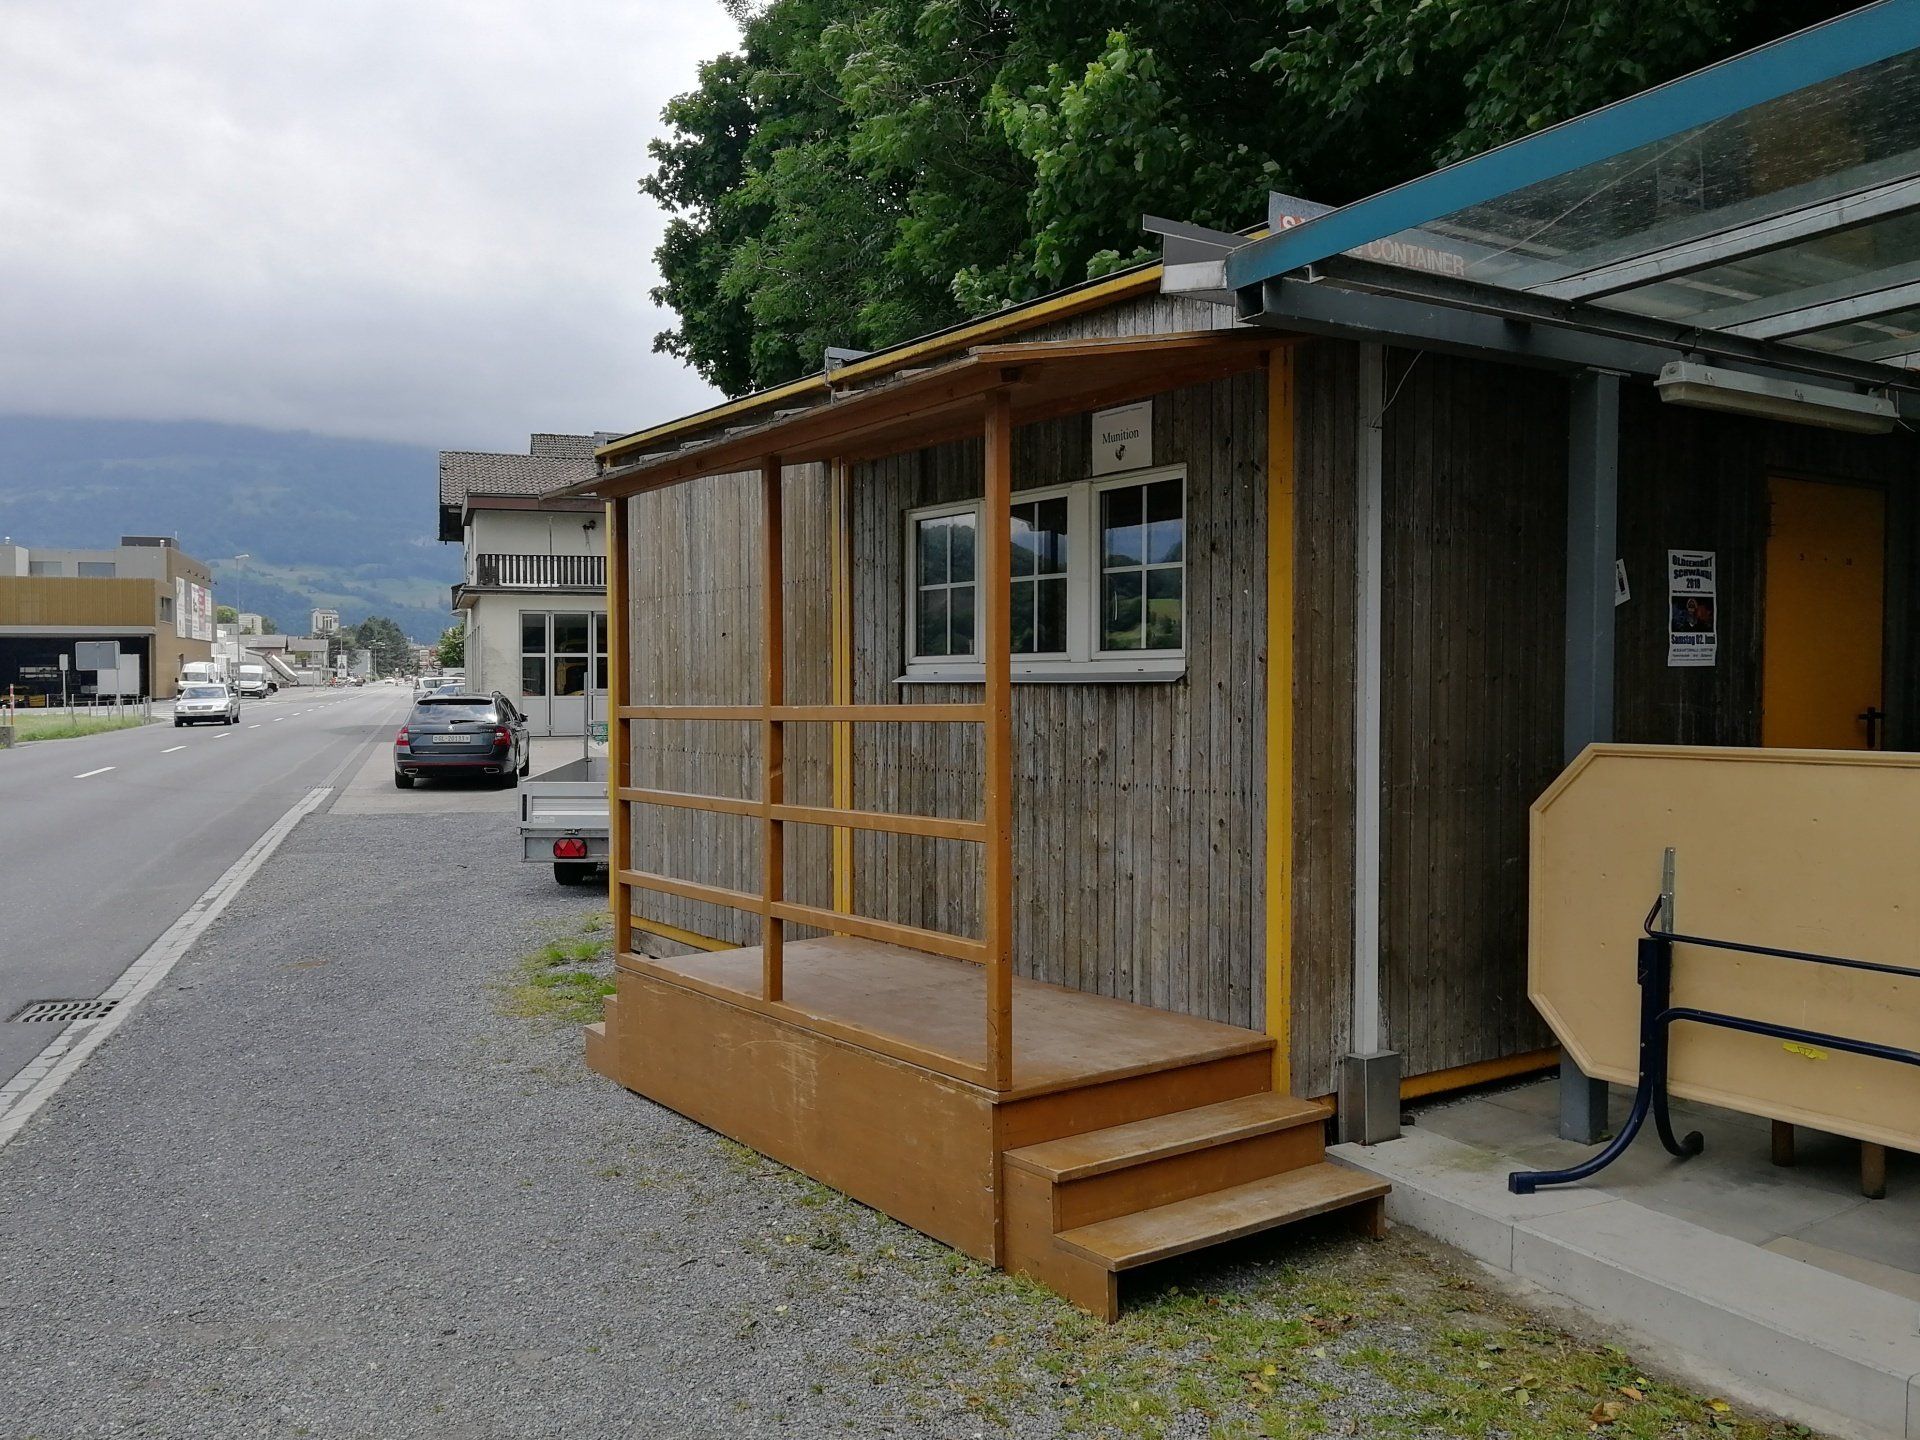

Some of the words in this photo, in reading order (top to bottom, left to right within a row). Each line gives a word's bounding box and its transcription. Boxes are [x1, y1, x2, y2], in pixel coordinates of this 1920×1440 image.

[1367, 239, 1464, 277] CONTAINER
[1102, 427, 1139, 444] Munition
[1671, 634, 1695, 645] Samstag
